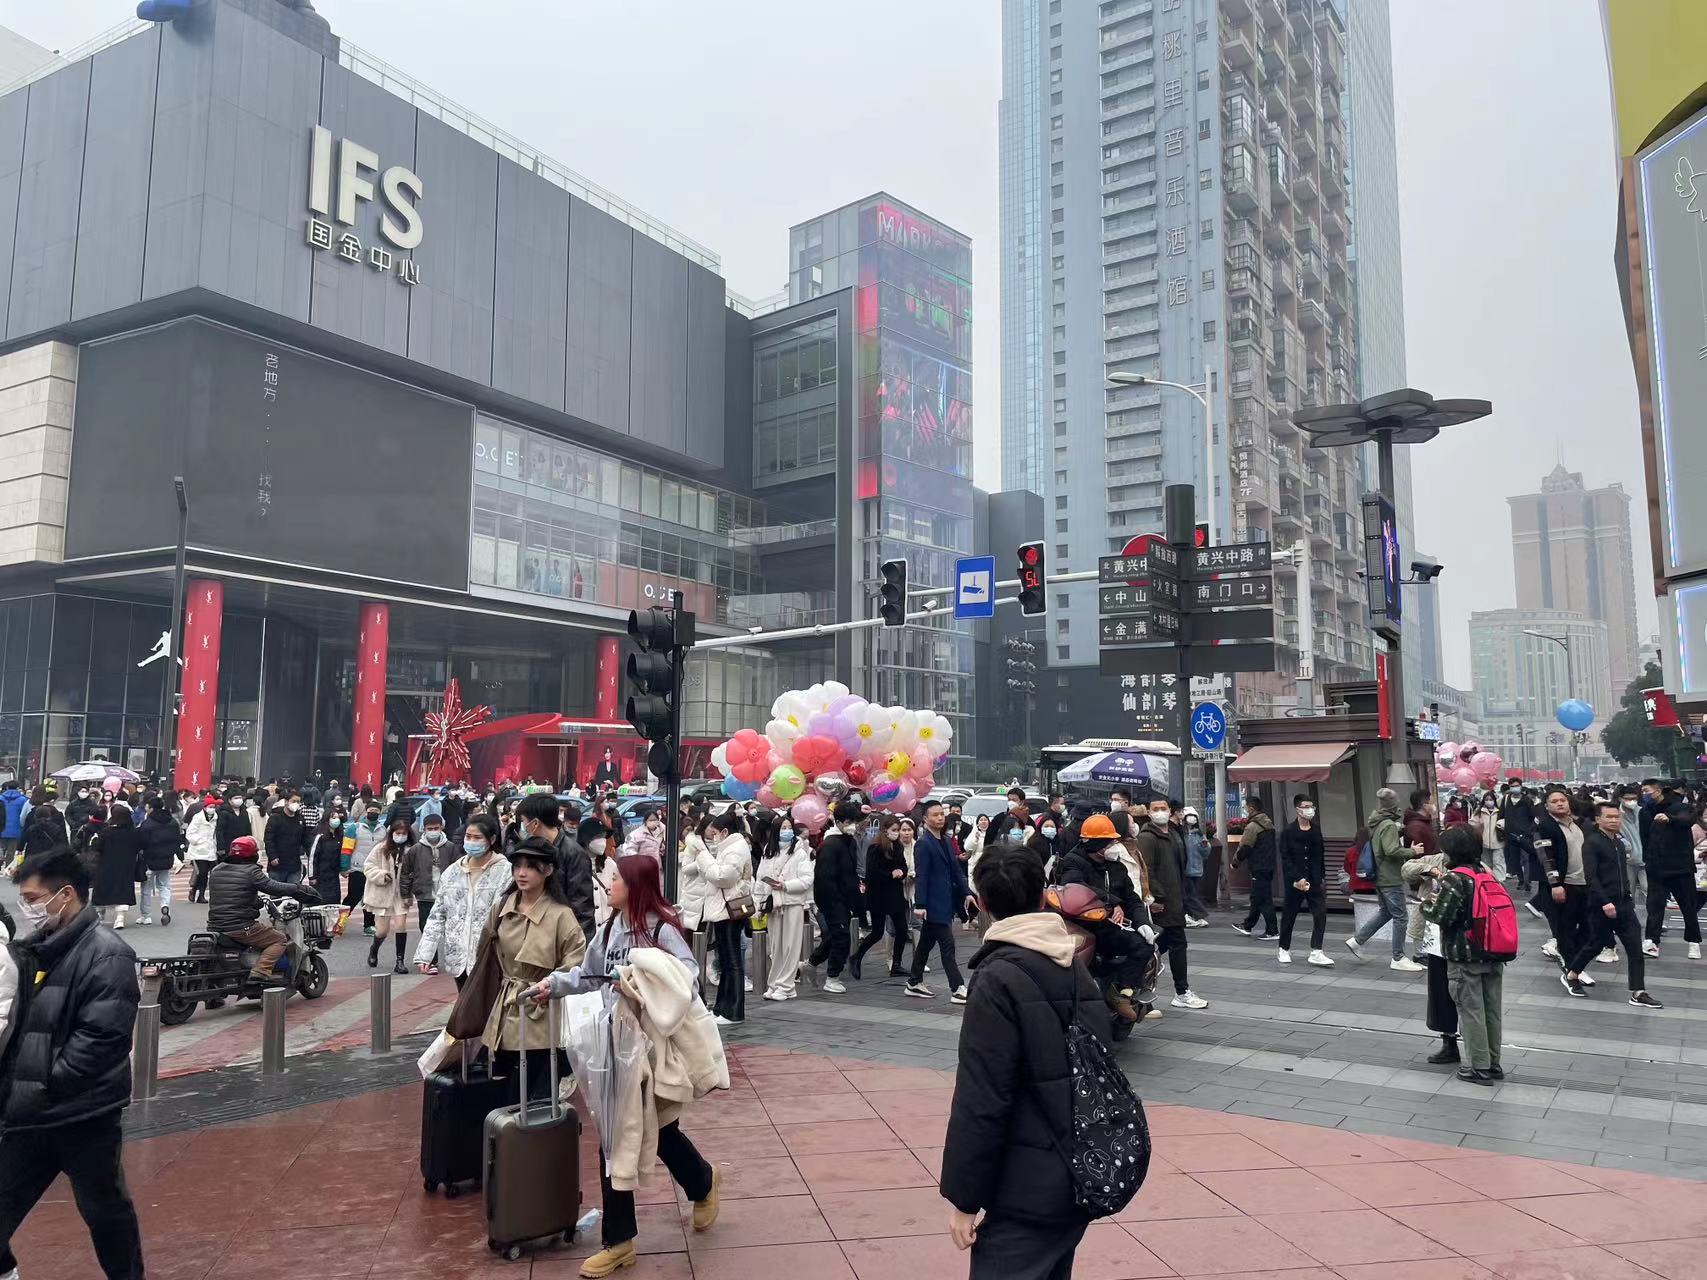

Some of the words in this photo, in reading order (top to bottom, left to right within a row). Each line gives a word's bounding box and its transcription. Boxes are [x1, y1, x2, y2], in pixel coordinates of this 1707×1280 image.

[308, 124, 424, 249] IFS
[308, 217, 421, 285] 国金中心
[1196, 547, 1254, 567] 黄兴中路
[1197, 583, 1253, 599] 南门口
